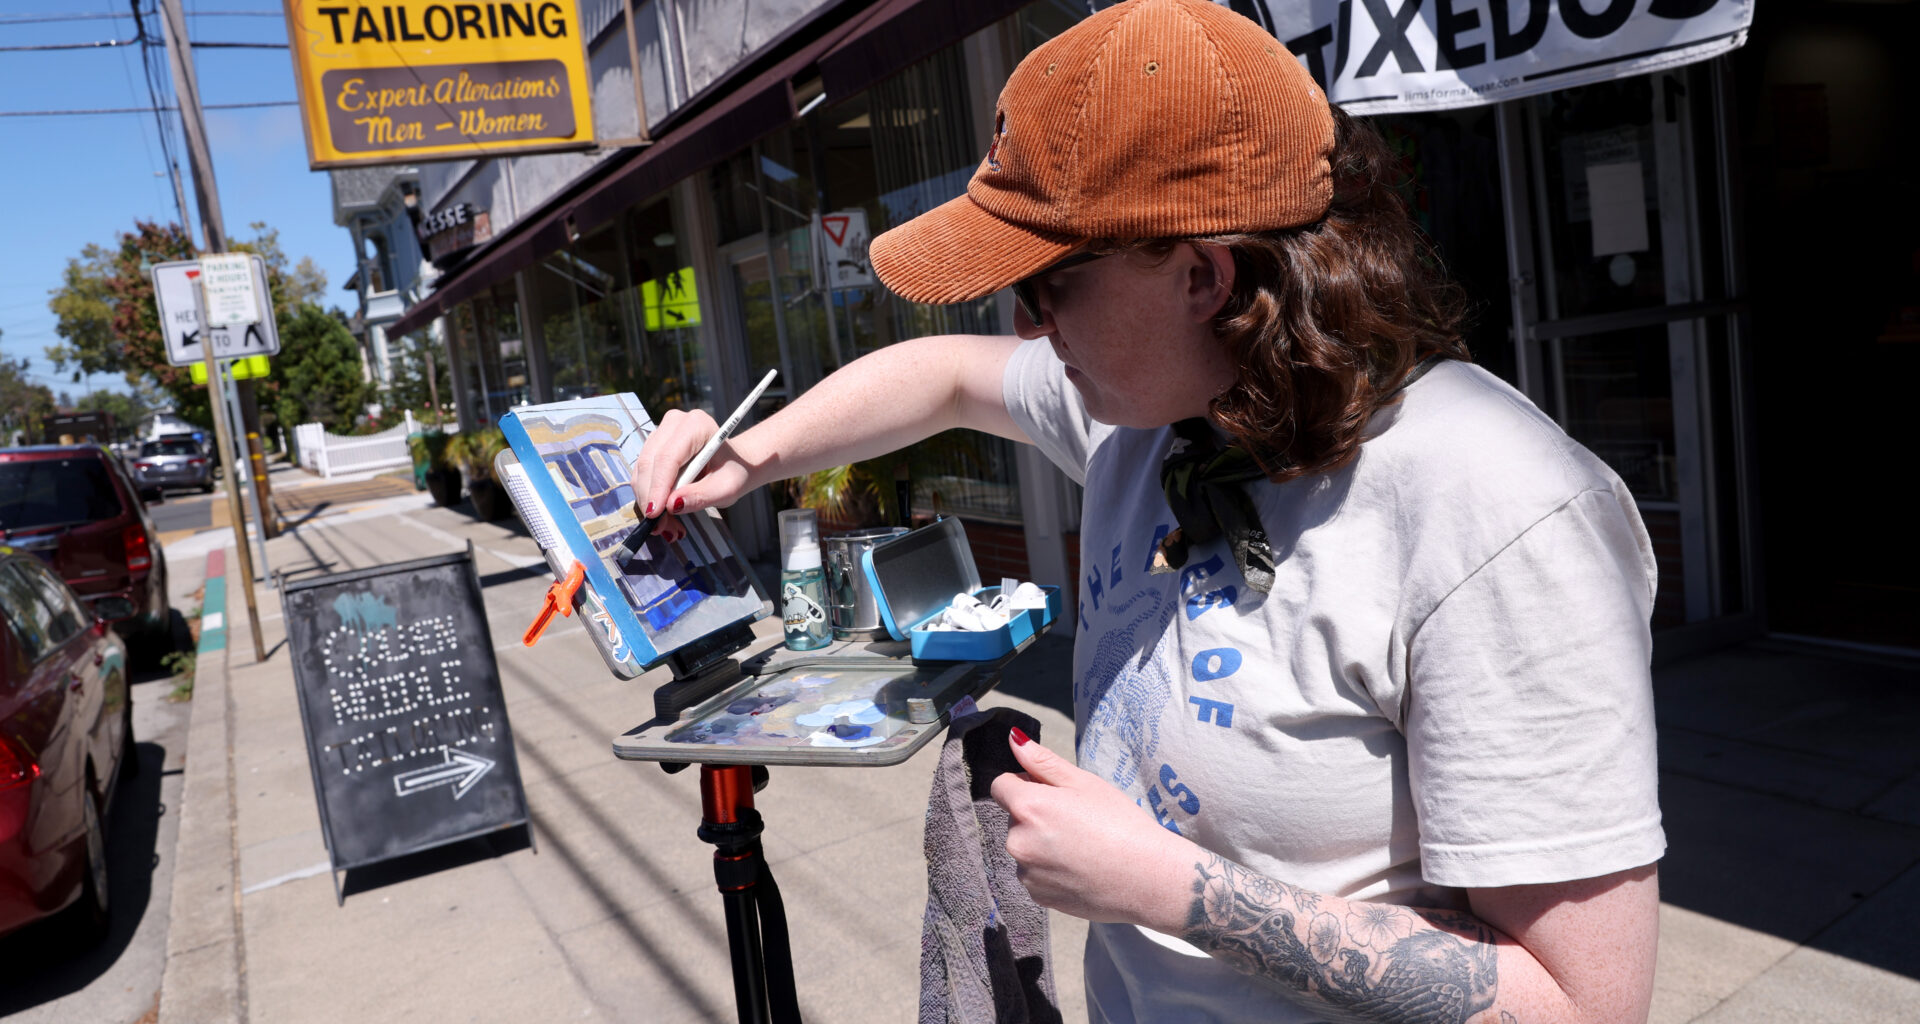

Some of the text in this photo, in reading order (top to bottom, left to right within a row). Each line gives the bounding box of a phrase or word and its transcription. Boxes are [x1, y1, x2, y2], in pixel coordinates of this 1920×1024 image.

[318, 2, 568, 44] TAILORING
[1286, 0, 1722, 97] TXED
[337, 69, 560, 113] Expert Alterations
[354, 116, 425, 145] Men
[459, 108, 548, 136] Women
[175, 309, 199, 324] HE
[214, 335, 231, 348] TO
[1080, 541, 1123, 632] THE
[1189, 647, 1243, 729] OF
[330, 659, 471, 726] NEEDLE
